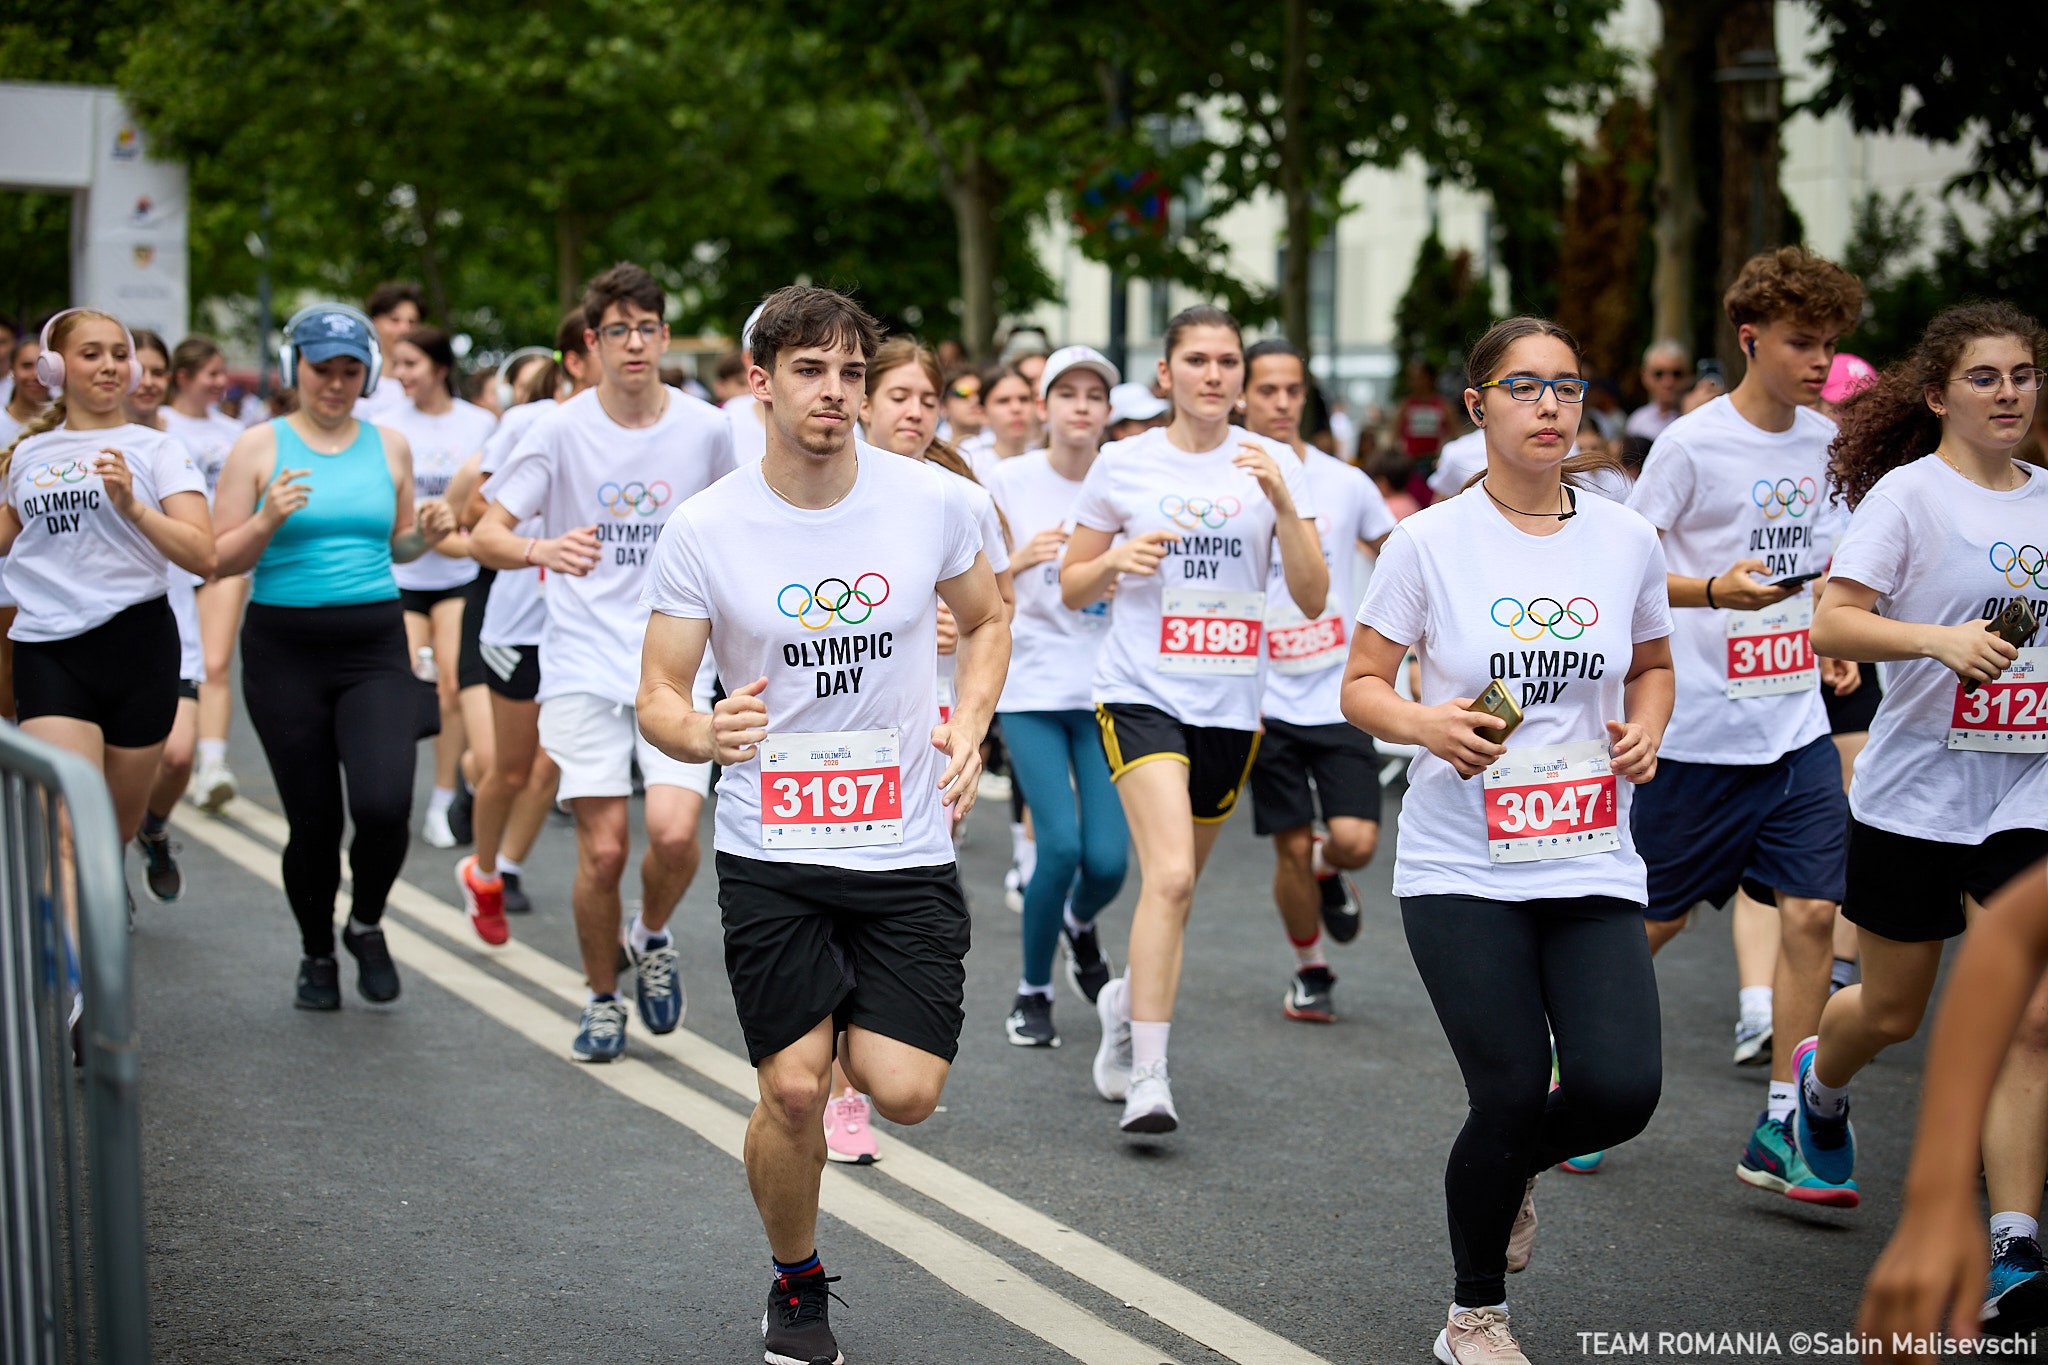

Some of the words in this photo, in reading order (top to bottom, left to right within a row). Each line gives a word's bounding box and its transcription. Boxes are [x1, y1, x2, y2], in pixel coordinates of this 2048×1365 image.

[24, 490, 100, 518] OLYMPIC
[46, 513, 81, 535] DAY
[616, 547, 648, 566] DAY
[1184, 559, 1219, 579] DAY
[1767, 553, 1797, 575] DAY
[783, 632, 893, 667] OLYMPIC
[1165, 619, 1249, 653] 3198
[1490, 651, 1605, 680] OLYMPIC
[1733, 633, 1804, 674] 3101
[816, 666, 864, 698] DAY
[1521, 681, 1569, 708] DAY
[823, 759, 839, 767] 2026
[772, 774, 884, 818] 3197
[1496, 783, 1602, 833] 3047
